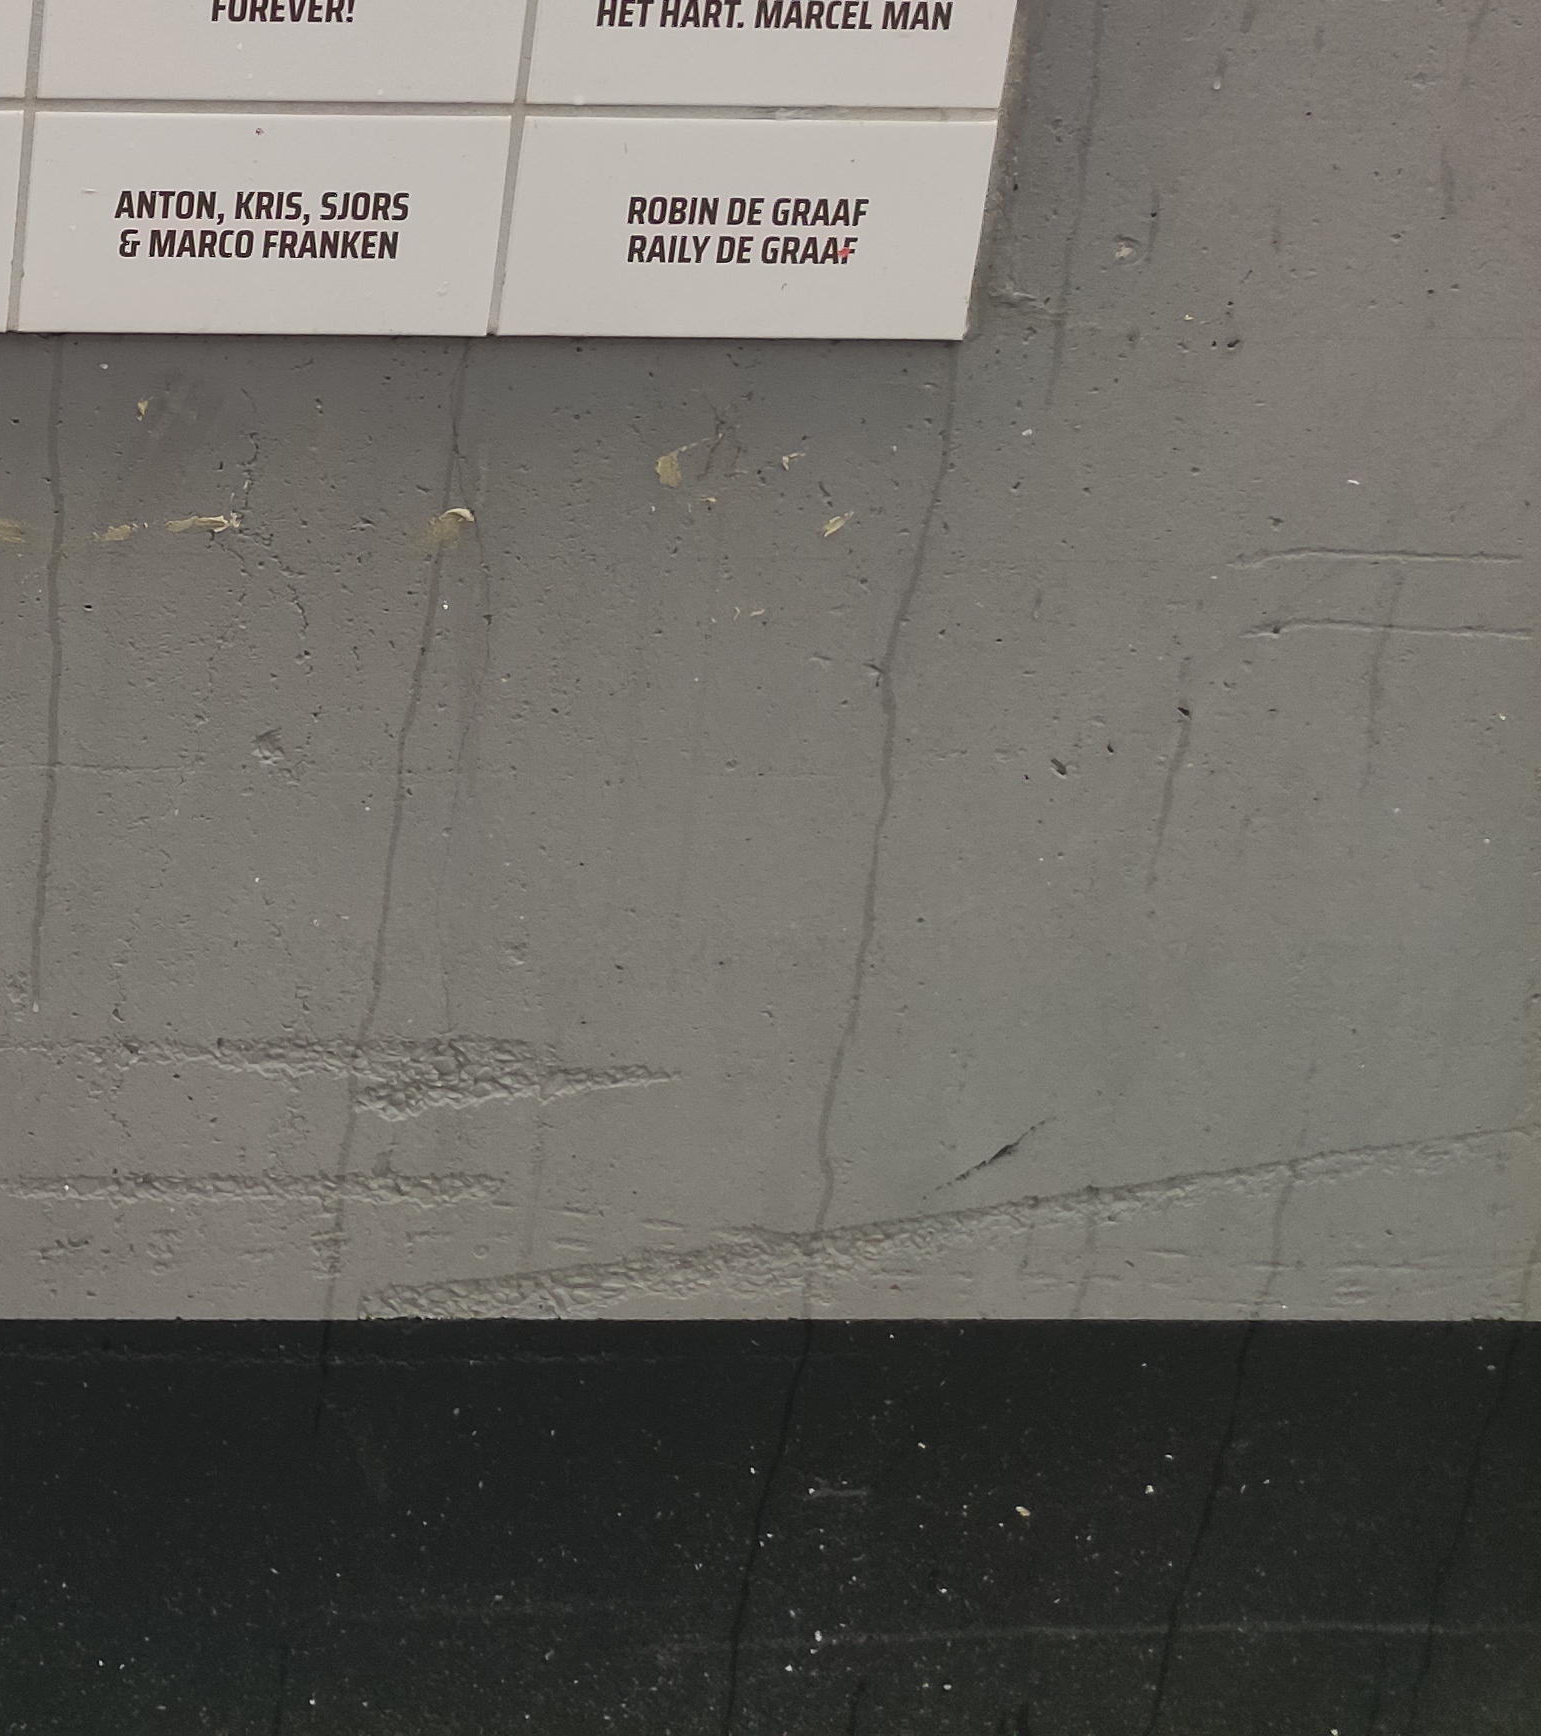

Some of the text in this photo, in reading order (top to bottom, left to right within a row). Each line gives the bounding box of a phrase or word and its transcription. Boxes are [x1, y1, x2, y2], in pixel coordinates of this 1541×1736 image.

[754, 0, 873, 30] MARCEL
[881, 0, 954, 31] MAN
[114, 190, 410, 226] ANTON, KRIS, SJORS
[626, 196, 870, 227] ROBIN DE GRAAF
[118, 228, 400, 260] & MARCO FRANKEN
[627, 234, 859, 265] RAILY DE GRAAF
